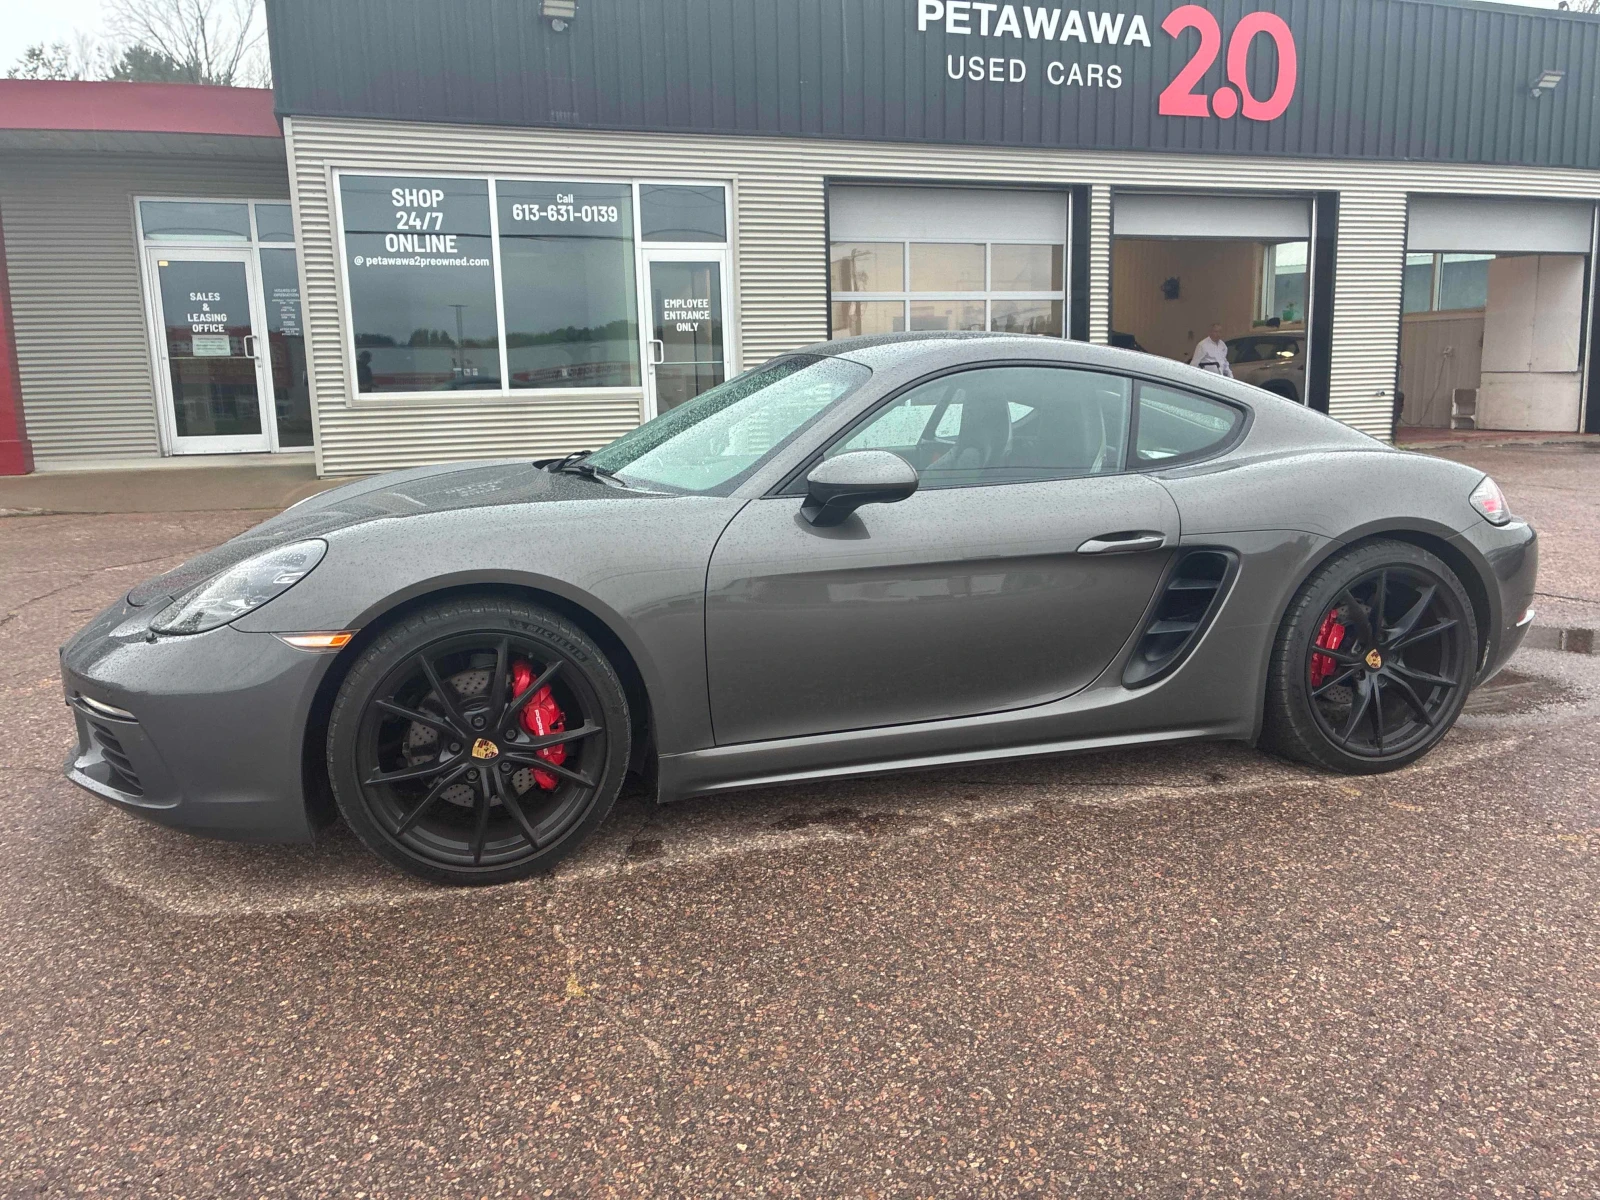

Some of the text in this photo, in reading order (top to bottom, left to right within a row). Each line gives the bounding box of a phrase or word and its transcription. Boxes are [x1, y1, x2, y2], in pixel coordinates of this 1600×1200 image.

[917, 0, 1151, 47] PETAWAWA
[1158, 4, 1297, 121] 2.0
[947, 54, 1122, 89] USED CARS
[391, 188, 444, 208] SHOP
[556, 193, 574, 203] Call
[396, 211, 443, 230] 24/7
[512, 204, 618, 222] 613-631-0139
[385, 233, 457, 253] ONLINE
[354, 255, 490, 267] @ petawawa2preowned.com
[190, 292, 220, 301] SALES
[664, 299, 709, 308] EMPLOYEE
[202, 303, 210, 311] &
[187, 313, 227, 322] LEASING
[664, 310, 710, 320] ENTRANCE
[192, 323, 225, 332] OFFICE
[676, 322, 699, 332] ONLY
[526, 624, 586, 660] MICHELIN
[534, 709, 549, 756] PORSE
